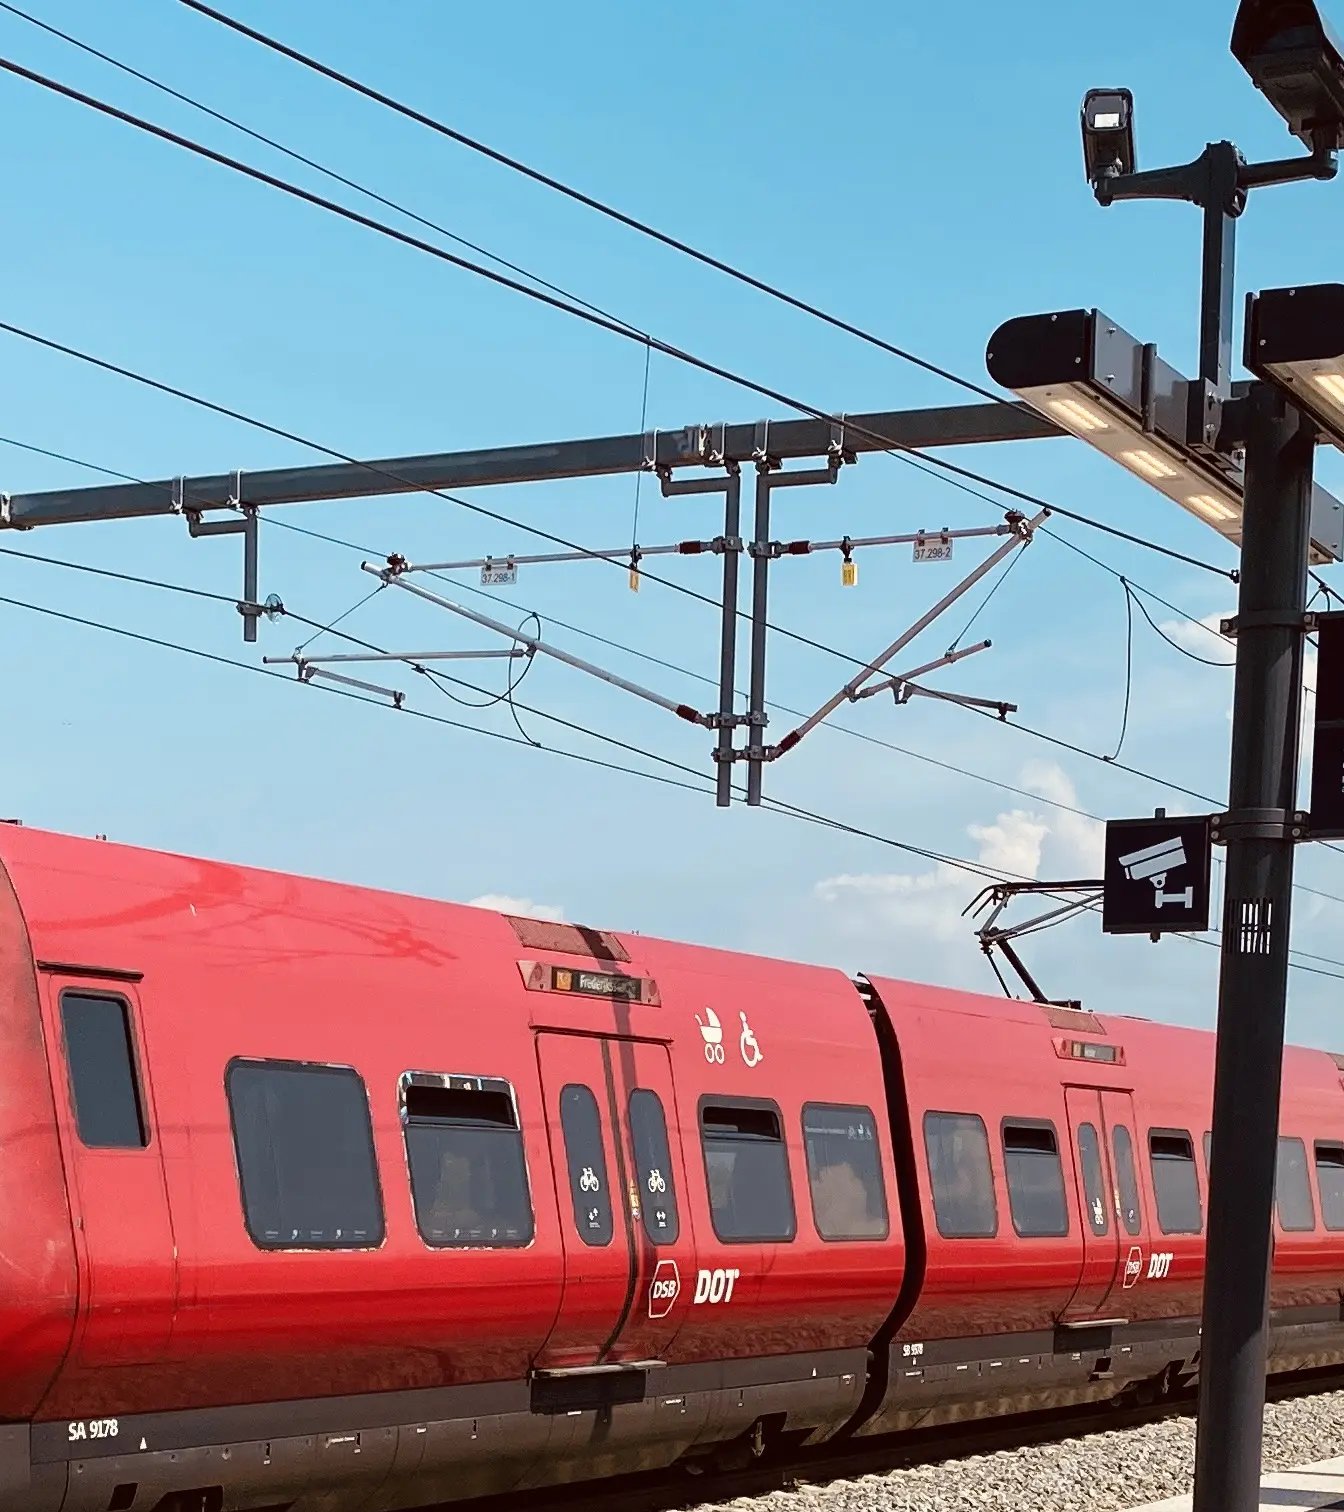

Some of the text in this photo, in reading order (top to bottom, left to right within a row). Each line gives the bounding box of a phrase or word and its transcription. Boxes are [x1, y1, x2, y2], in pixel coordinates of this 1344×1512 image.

[1147, 1252, 1174, 1278] DOT
[652, 1280, 677, 1299] DSB
[694, 1268, 739, 1304] DOT
[68, 1418, 119, 1441] SA 9178
